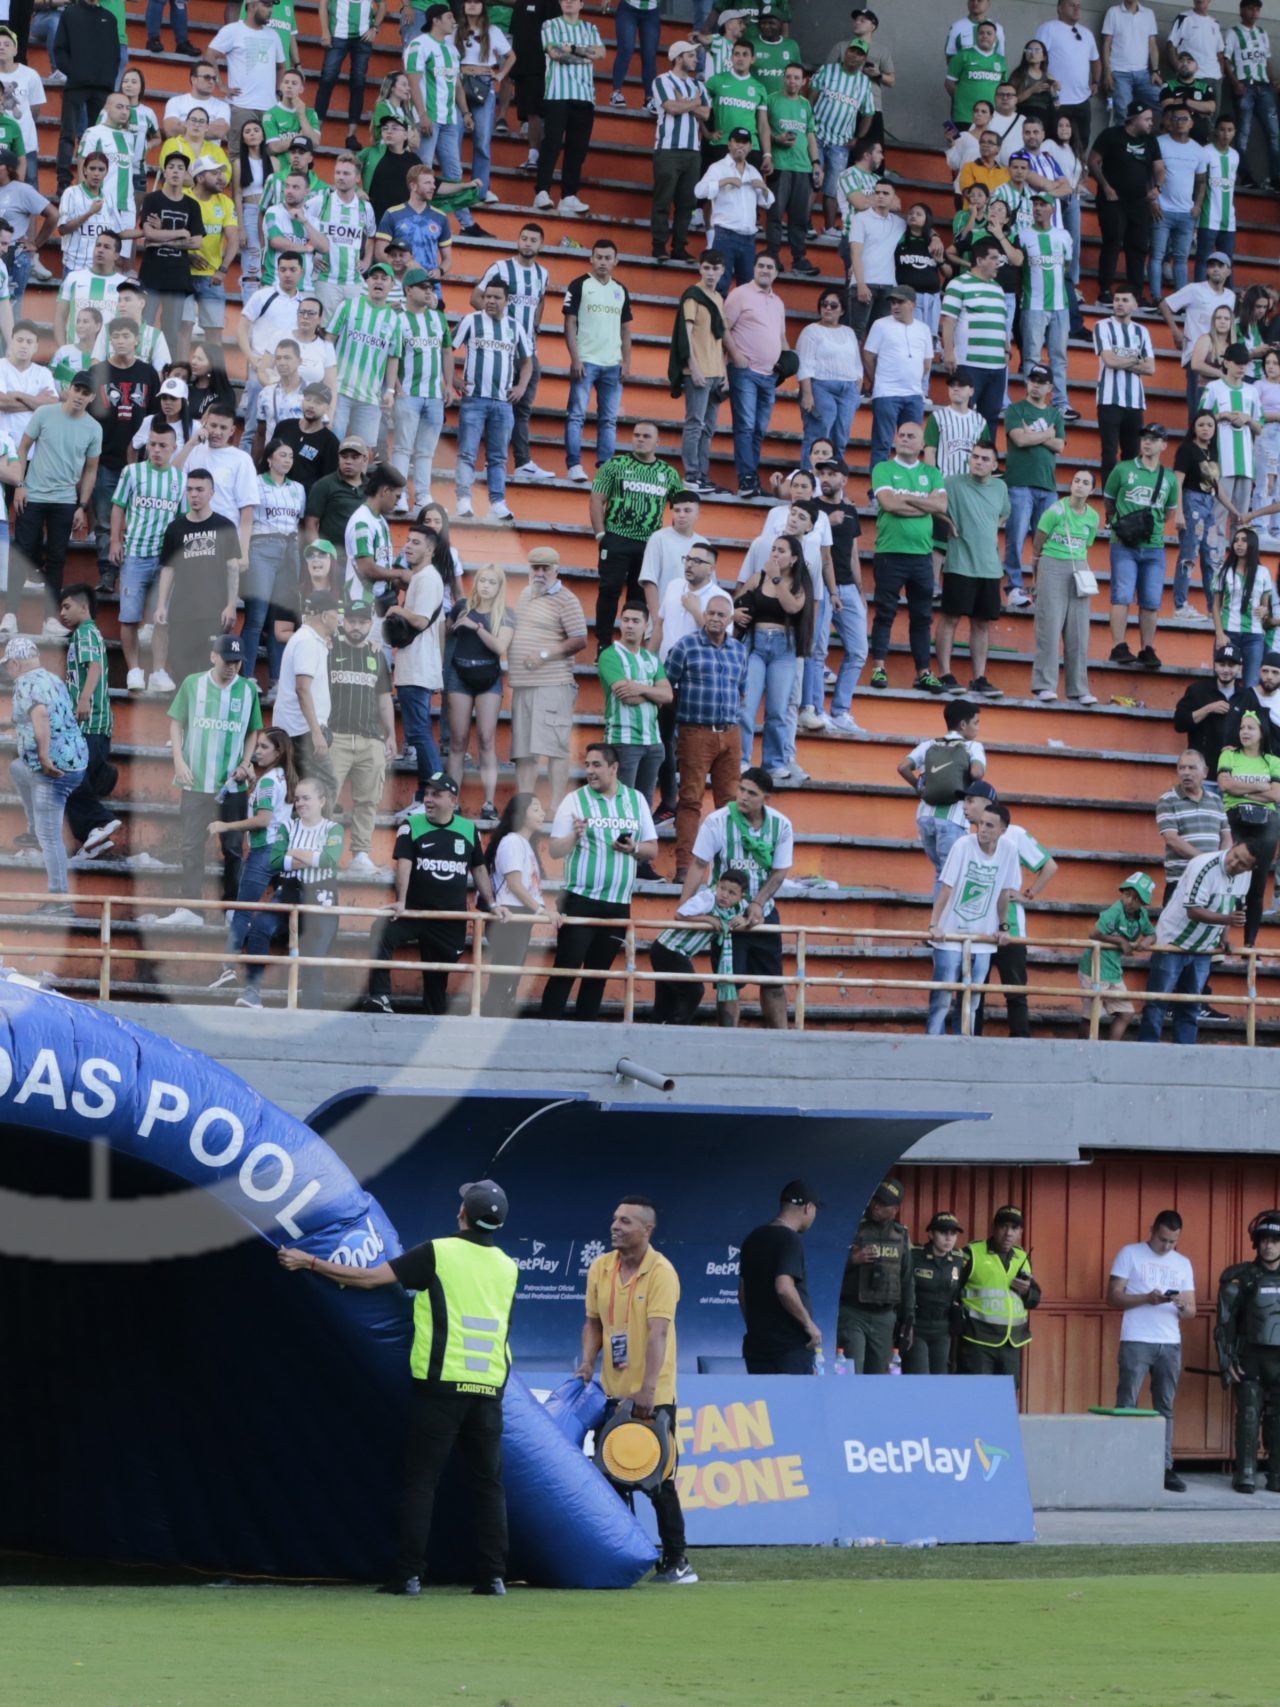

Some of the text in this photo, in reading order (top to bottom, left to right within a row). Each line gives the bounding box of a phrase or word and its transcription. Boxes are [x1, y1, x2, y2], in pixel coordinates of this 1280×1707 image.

[968, 71, 1003, 81] POSTOBON
[718, 96, 757, 112] POSTOBON
[347, 331, 387, 350] POSTOBON
[623, 480, 668, 497] POSTOBON
[135, 495, 179, 512] POSTOBON
[183, 530, 218, 543] ARMANI
[330, 670, 378, 688] POSTOBON
[193, 717, 242, 733] POSTOBON
[588, 817, 639, 831] POSTOBON
[417, 857, 468, 876] POSTOBON
[136, 1079, 322, 1240] POOL
[328, 1217, 384, 1268] Pool
[705, 1261, 741, 1276] BetPl
[456, 1383, 497, 1397] LOGISTICA
[676, 1399, 775, 1455] FAN
[844, 1437, 972, 1482] BetPlay
[675, 1455, 810, 1510] ZONE
